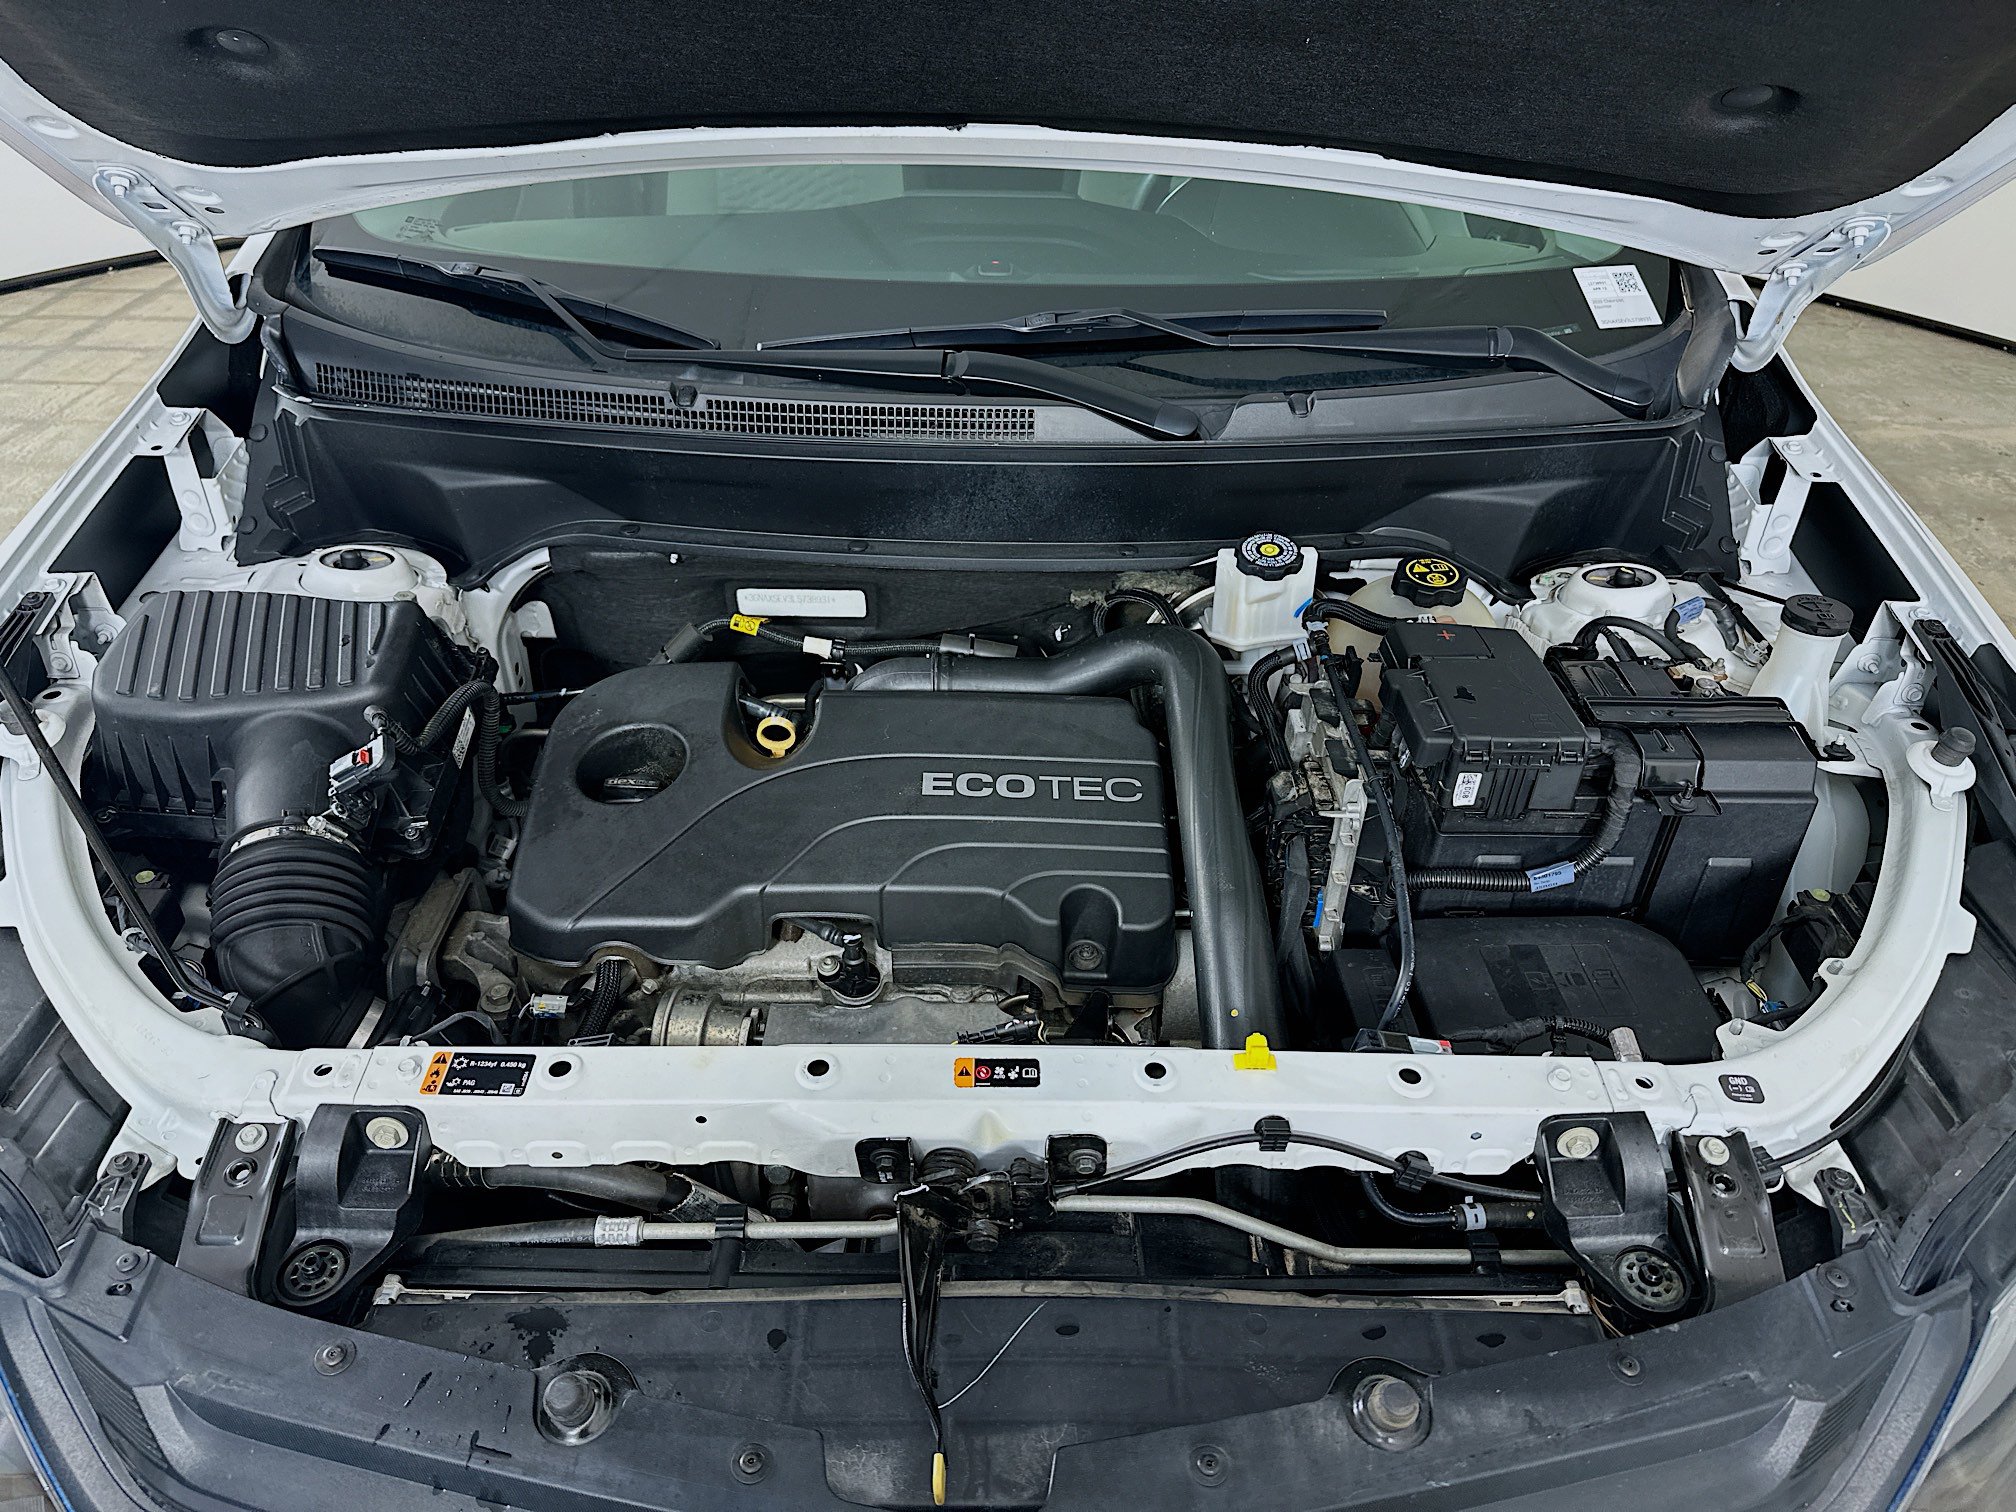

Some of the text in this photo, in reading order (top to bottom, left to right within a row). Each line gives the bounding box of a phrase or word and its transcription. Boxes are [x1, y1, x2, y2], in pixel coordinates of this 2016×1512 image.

[921, 772, 1143, 803] ECOTEC
[469, 1060, 498, 1069] R-1234yf
[518, 1061, 527, 1069] kg
[1728, 1076, 1748, 1086] GND
